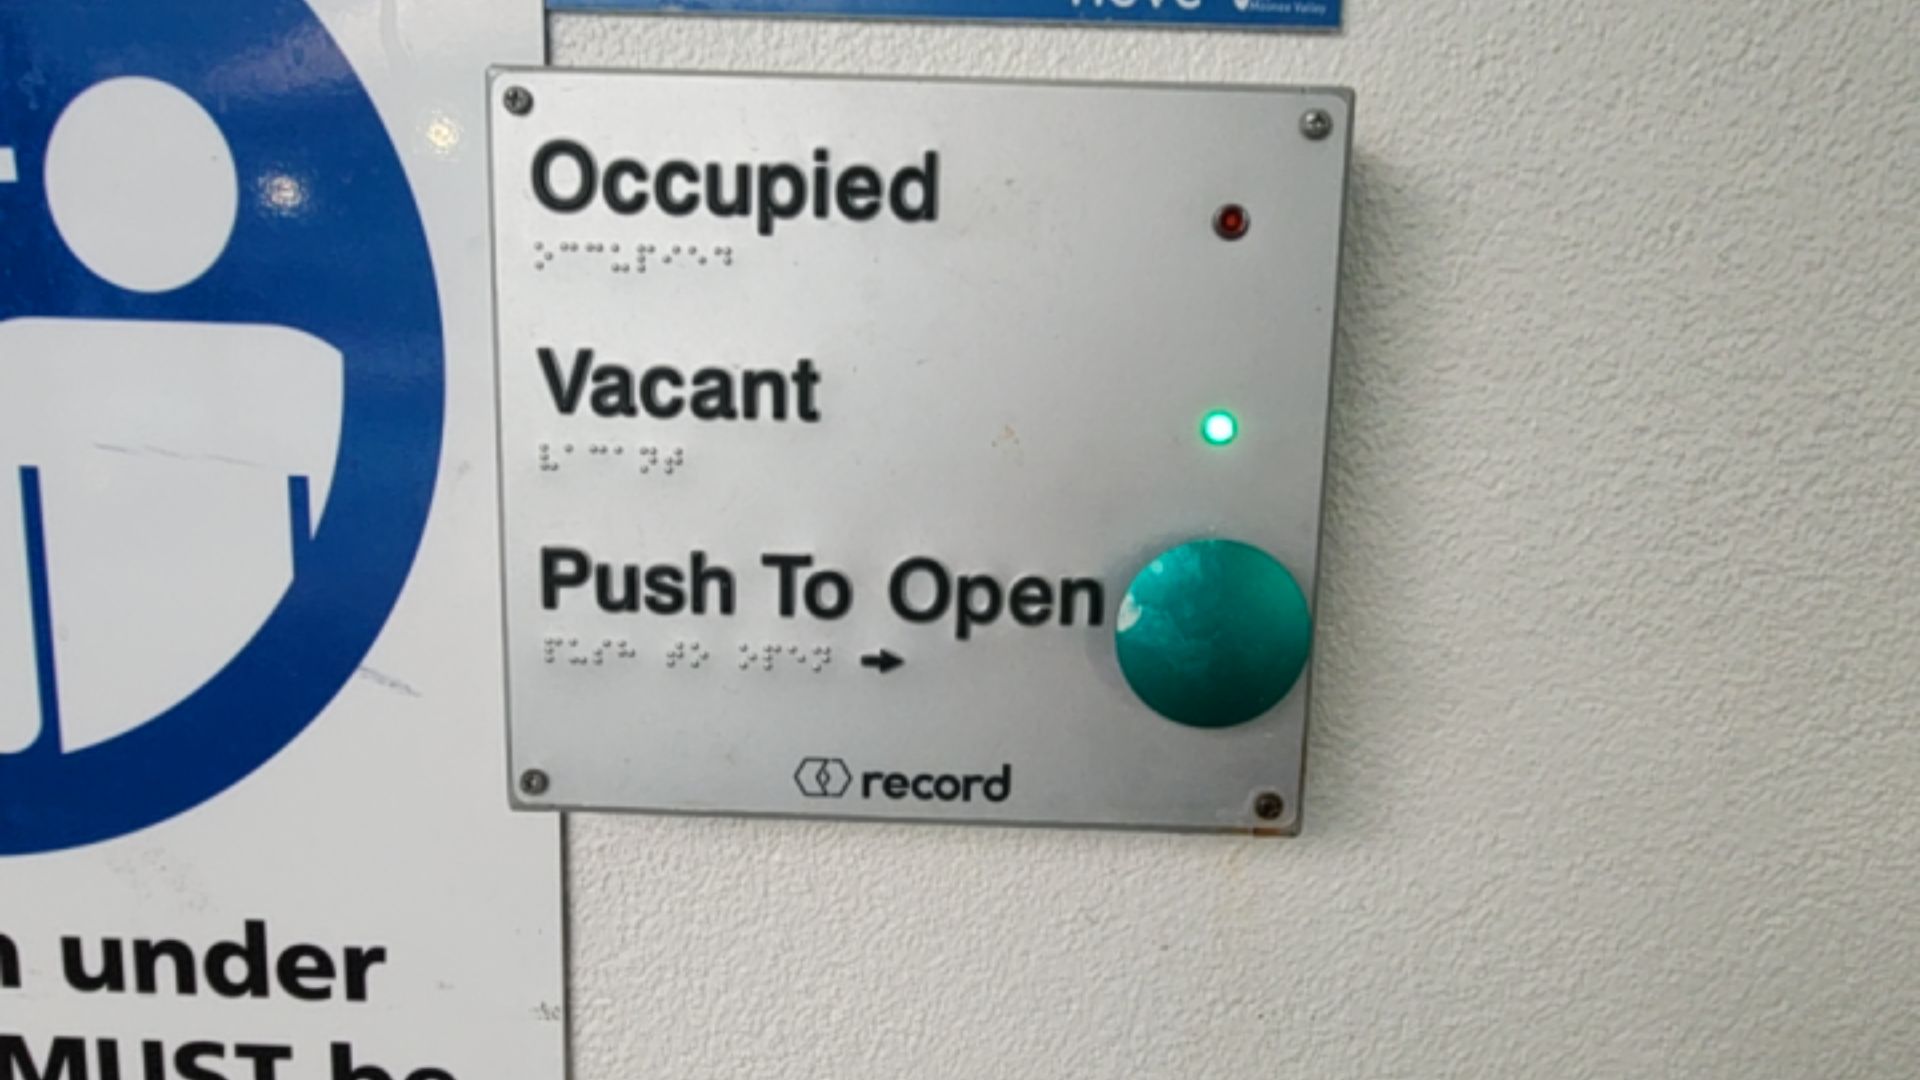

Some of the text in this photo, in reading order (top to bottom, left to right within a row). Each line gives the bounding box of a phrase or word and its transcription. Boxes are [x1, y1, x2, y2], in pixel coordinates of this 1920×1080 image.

[532, 140, 938, 236] Occupied
[538, 348, 820, 423] Vacant
[541, 547, 1105, 641] Push To Open
[861, 763, 1012, 803] record
[61, 919, 386, 1002] under
[0, 1034, 293, 1080] MUST
